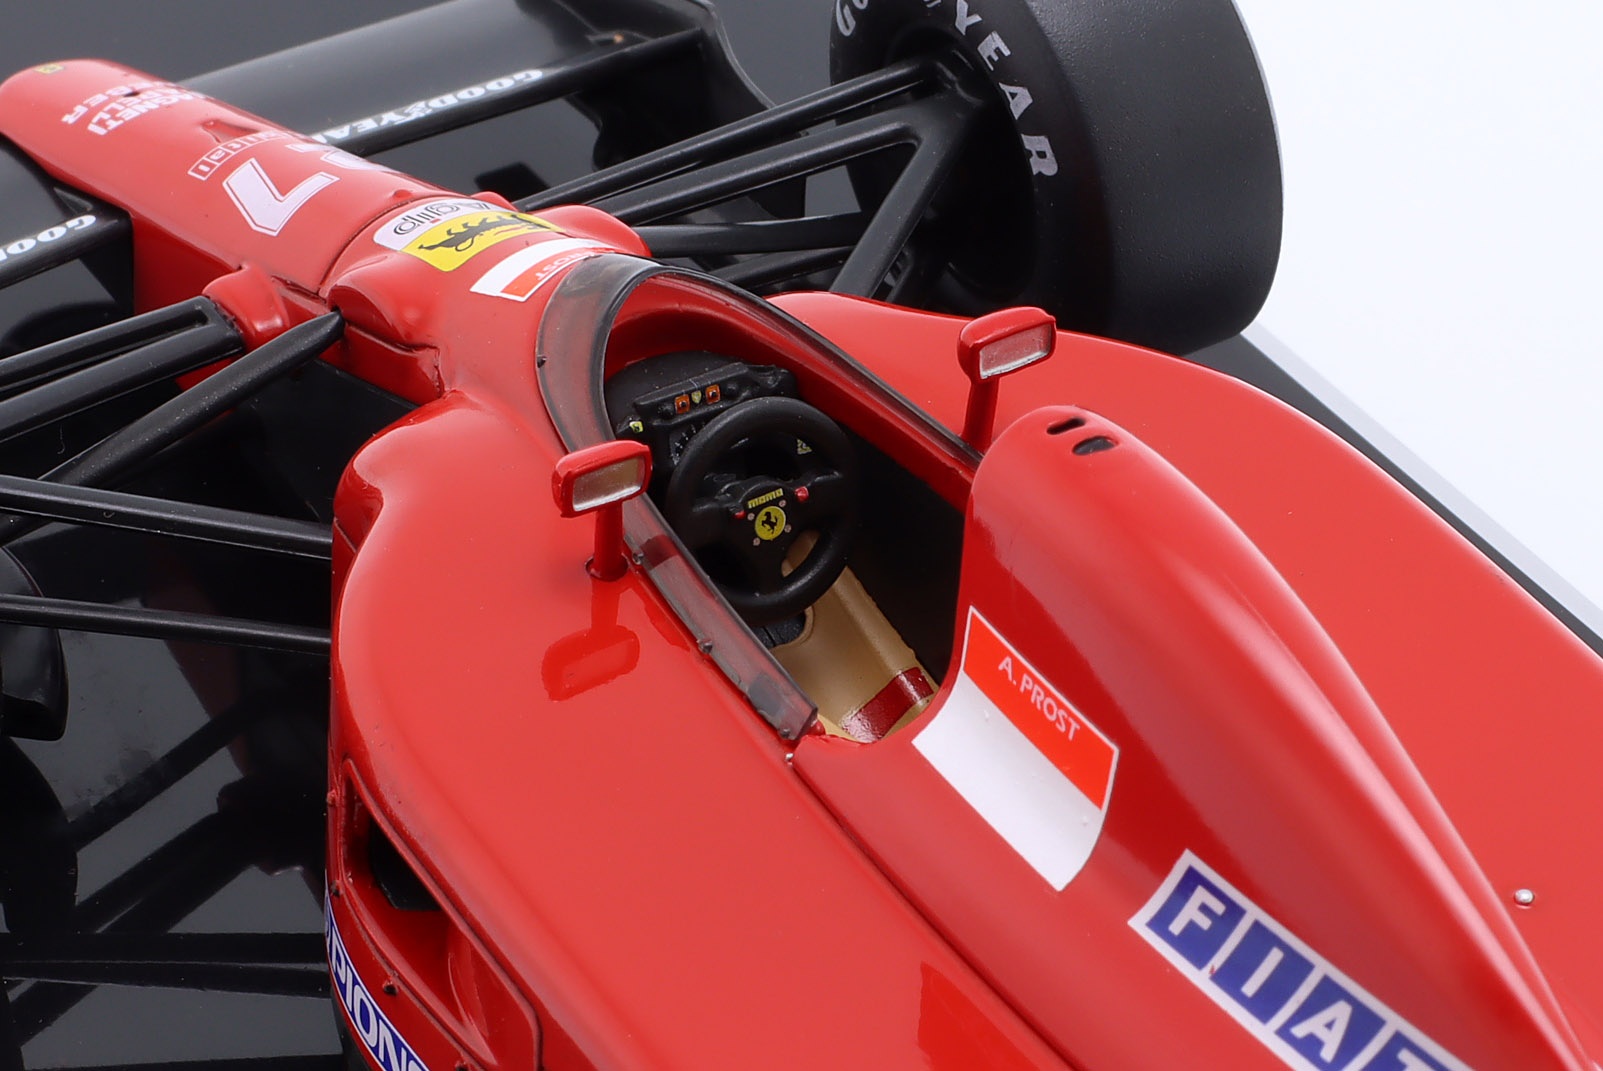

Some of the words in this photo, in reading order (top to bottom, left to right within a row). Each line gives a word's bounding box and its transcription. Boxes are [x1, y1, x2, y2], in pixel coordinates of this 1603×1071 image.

[0, 214, 97, 262] GOO
[998, 655, 1017, 685] A.
[1019, 673, 1081, 741] PROST
